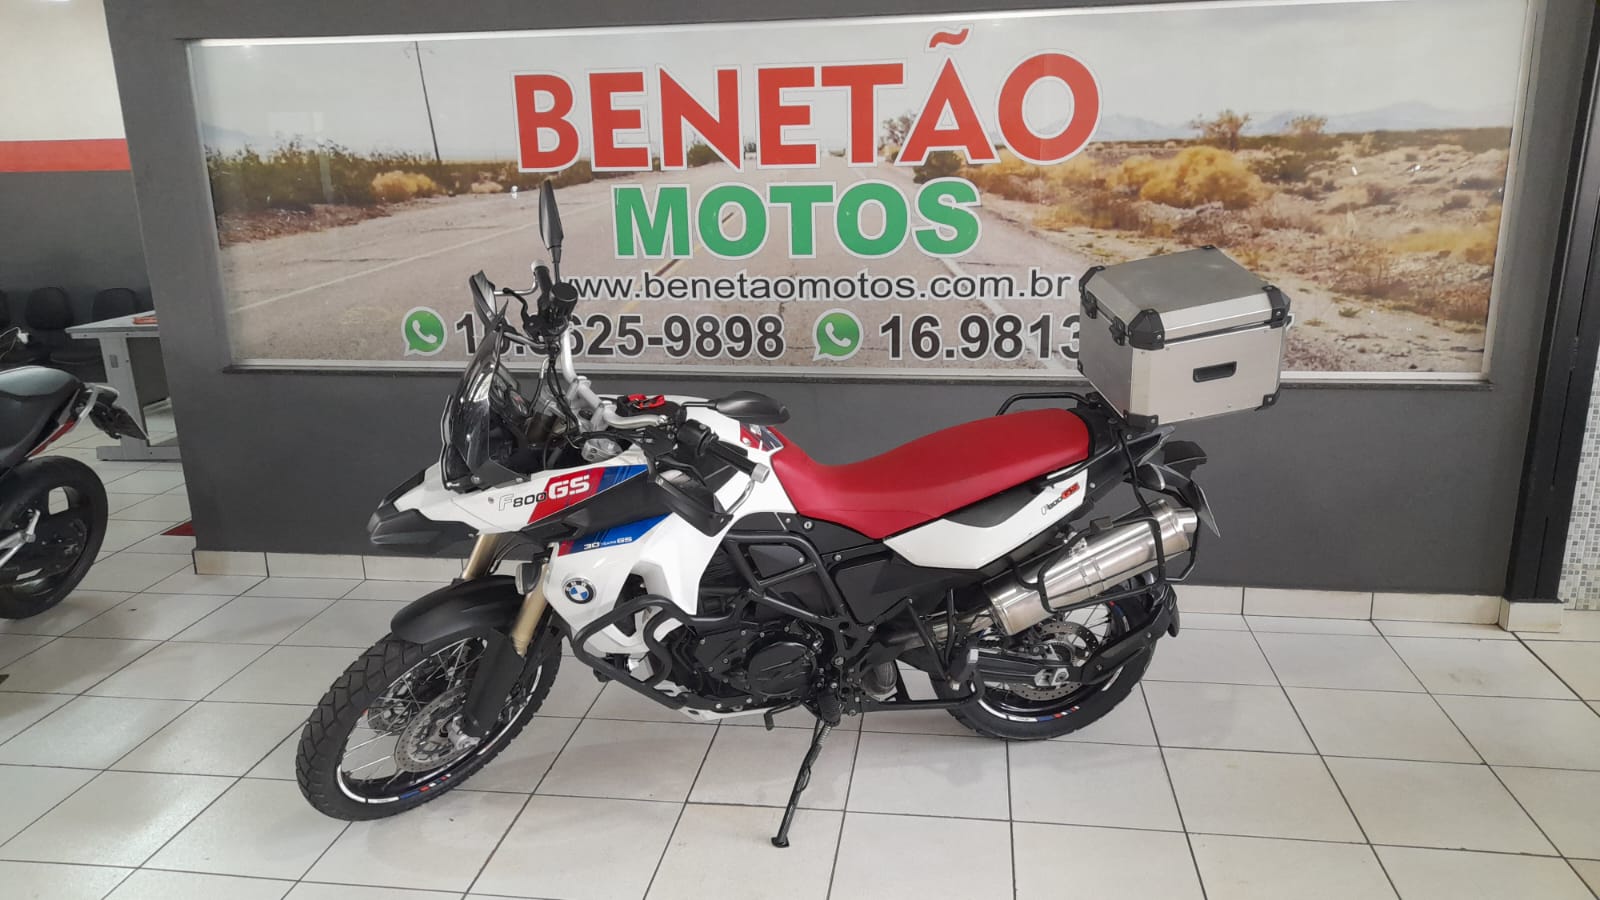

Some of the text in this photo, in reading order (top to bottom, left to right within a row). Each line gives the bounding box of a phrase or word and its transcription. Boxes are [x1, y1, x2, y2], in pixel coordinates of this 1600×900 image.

[513, 28, 1100, 170] BENETÃO
[613, 180, 980, 257] MOTOS
[560, 269, 1071, 300] ww.benetaomotos.com.br
